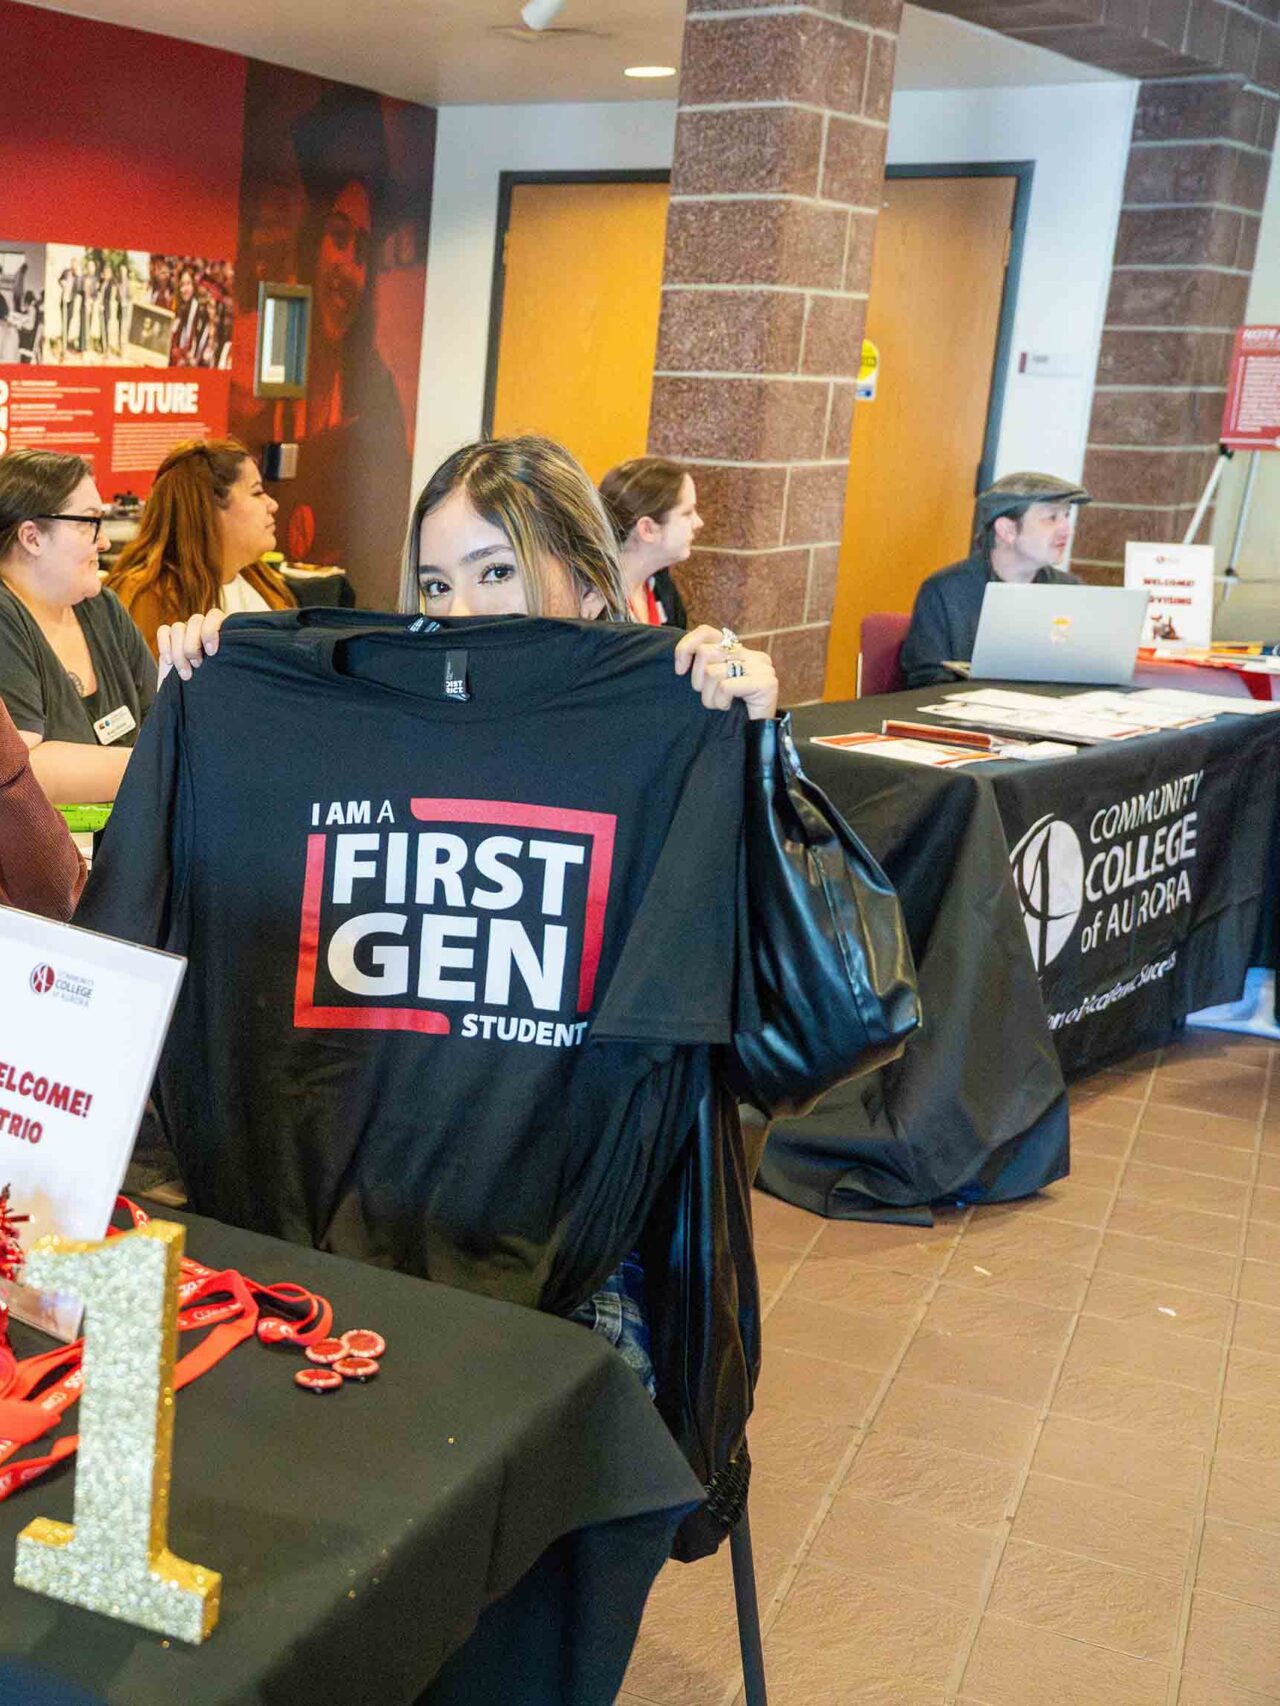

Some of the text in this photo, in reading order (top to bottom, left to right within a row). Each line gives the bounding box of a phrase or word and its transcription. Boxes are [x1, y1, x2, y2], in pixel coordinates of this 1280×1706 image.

[114, 382, 198, 414] FUTURE
[311, 800, 395, 826] I AM A
[1089, 770, 1204, 845] COMMUNITY
[332, 832, 585, 917] FIRST
[1085, 813, 1198, 902] COLLEGE
[1081, 870, 1191, 955] of AURORA
[55, 979, 93, 999] COLLEGE
[327, 912, 568, 1012] GEN
[461, 1013, 587, 1048] STUDENT
